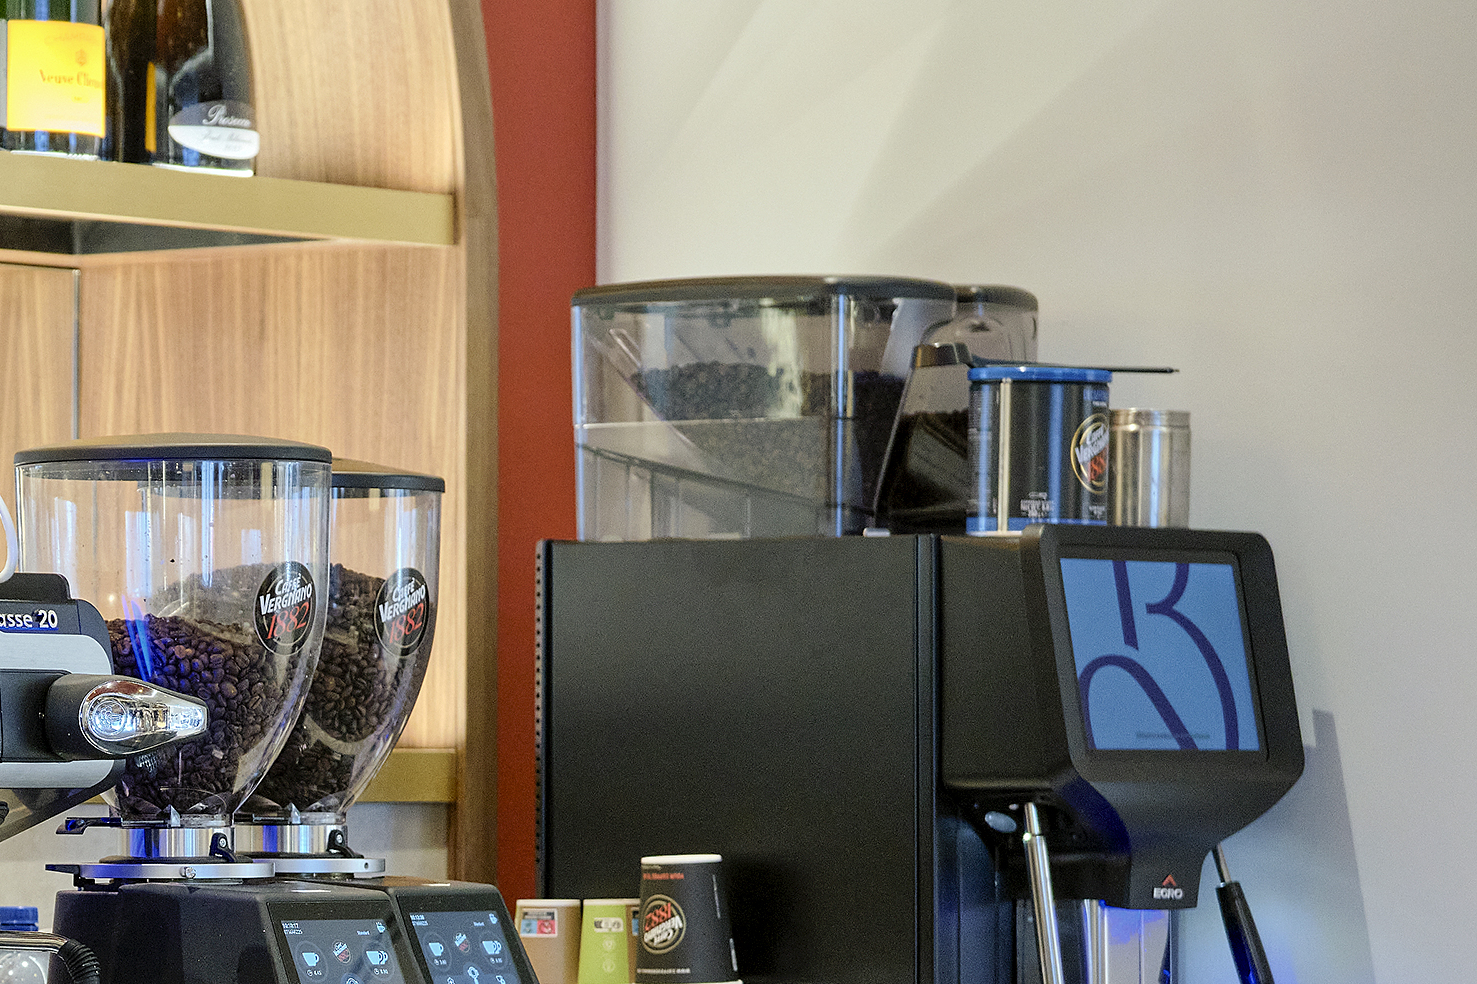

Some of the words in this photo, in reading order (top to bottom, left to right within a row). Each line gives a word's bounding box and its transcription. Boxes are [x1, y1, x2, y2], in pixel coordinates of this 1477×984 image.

[39, 69, 74, 84] Veuve
[259, 583, 313, 615] VERGNANO
[378, 584, 425, 623] VERGNANO
[38, 609, 58, 629] 20
[266, 601, 310, 640] 1882
[389, 602, 424, 643] 1882
[1153, 888, 1183, 900] EGRO
